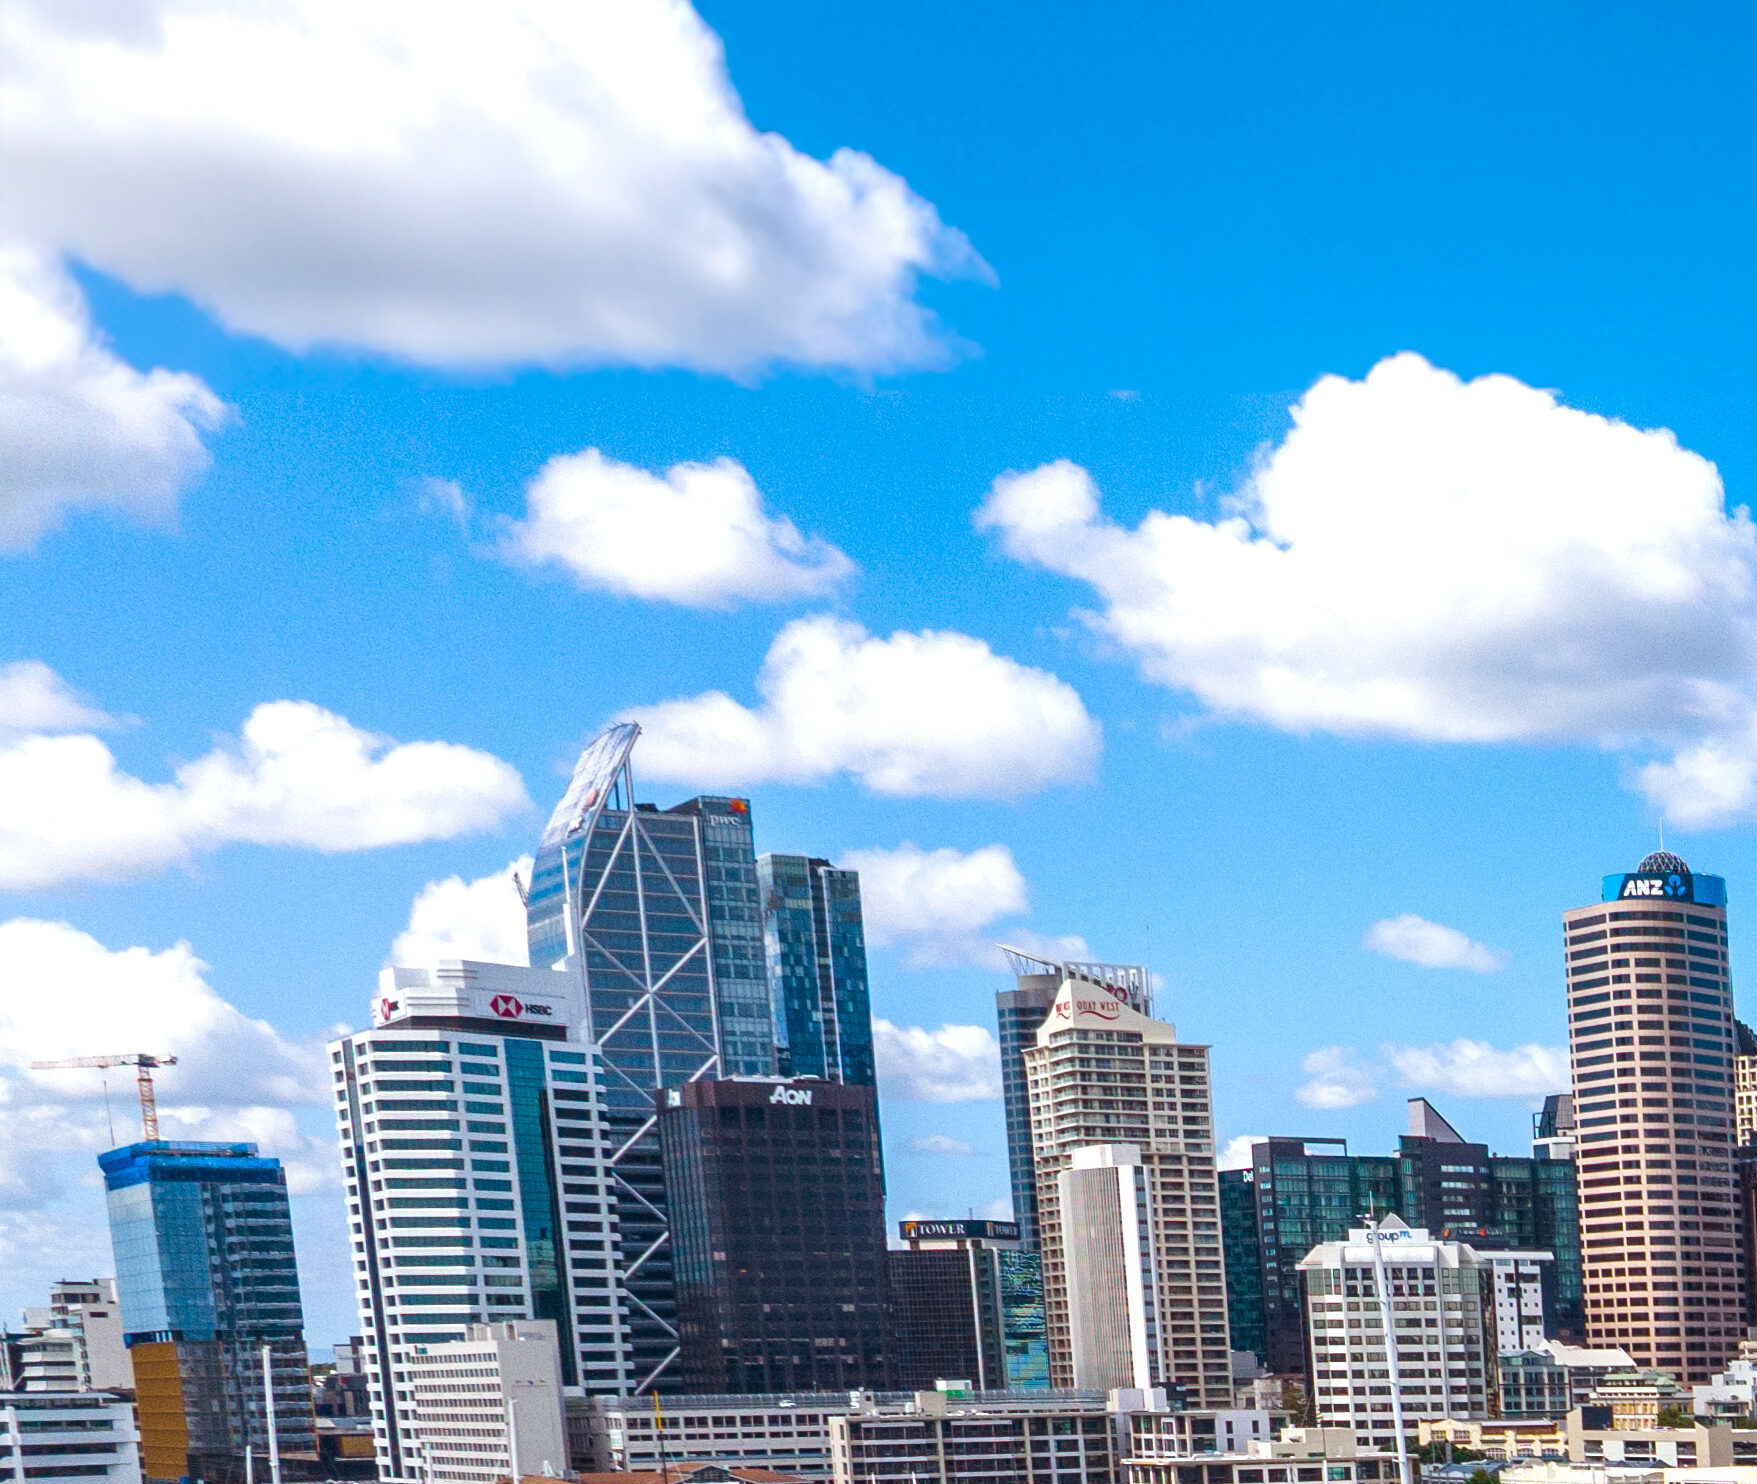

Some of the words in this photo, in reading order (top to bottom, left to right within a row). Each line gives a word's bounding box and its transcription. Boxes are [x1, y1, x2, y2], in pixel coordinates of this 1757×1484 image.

[1624, 879, 1664, 897] ANZ
[525, 1002, 553, 1018] HSBC
[919, 1222, 966, 1235] TOWER
